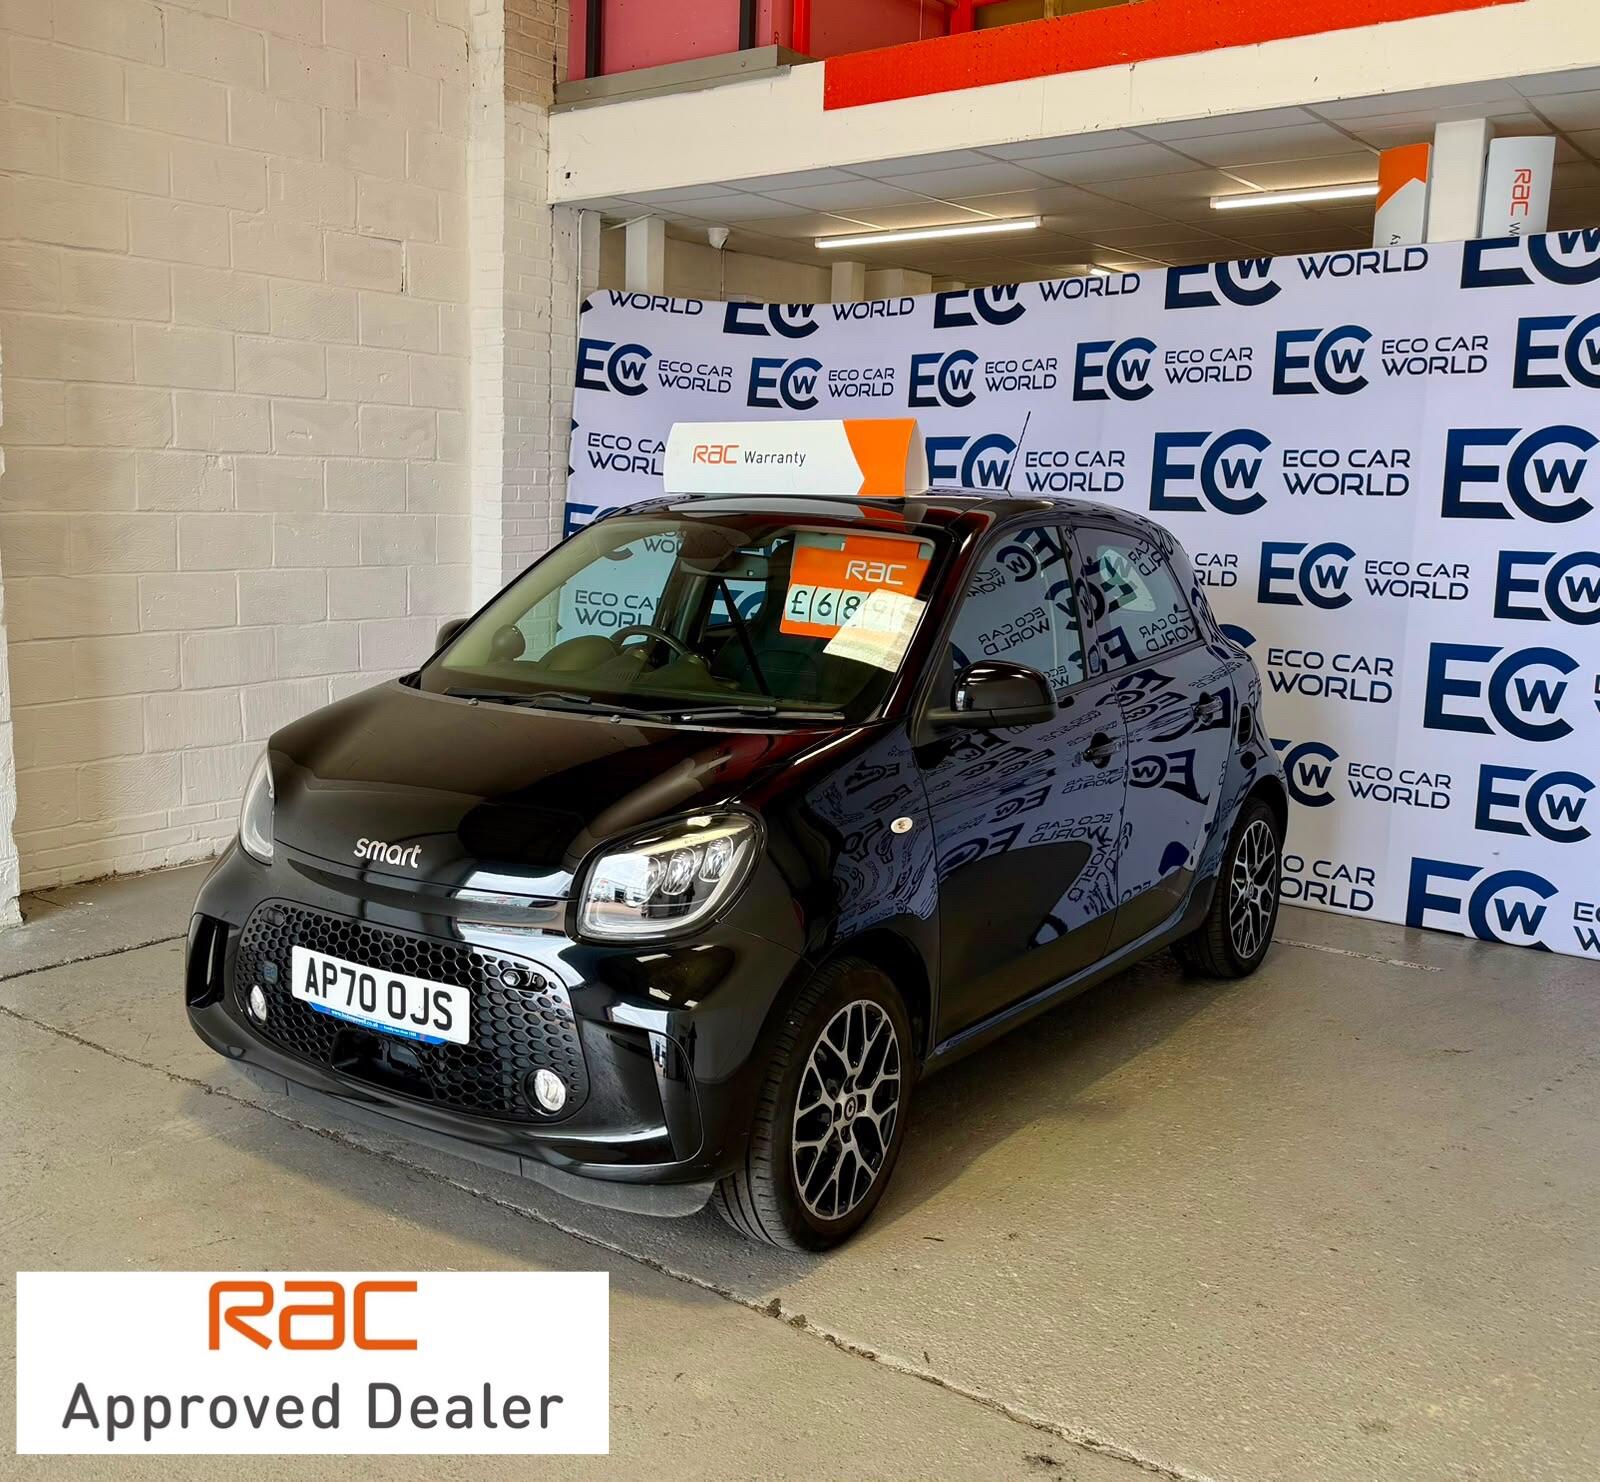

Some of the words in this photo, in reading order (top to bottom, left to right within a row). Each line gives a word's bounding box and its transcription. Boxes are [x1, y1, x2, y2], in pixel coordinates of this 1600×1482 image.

[1297, 247, 1429, 281] WORLD
[1039, 272, 1141, 302] WORLD
[608, 290, 703, 316] WORLD
[832, 298, 915, 321] WORLD
[1165, 349, 1204, 364] ECO
[1209, 347, 1253, 362] CAR
[1381, 338, 1429, 354] ECO
[1435, 335, 1489, 351] CAR
[658, 359, 692, 373] ECO
[697, 364, 733, 377] CAR
[828, 369, 860, 381] ECO
[862, 367, 895, 380] CAR
[985, 360, 1018, 374] ECO
[1022, 358, 1058, 371] CAR
[1164, 364, 1253, 384] WORLD
[1381, 354, 1488, 376] WORLD
[658, 373, 732, 393] WORLD
[828, 382, 895, 398] WORLD
[985, 373, 1057, 392] WORLD
[587, 432, 632, 450] ECO
[638, 439, 667, 454] CA
[587, 450, 663, 476] WORL
[744, 450, 806, 467] Warranty
[1025, 451, 1069, 467] ECO
[1075, 450, 1125, 467] CAR
[1283, 450, 1340, 468] ECO
[1349, 449, 1411, 468] CAR
[1025, 472, 1124, 492] WORLD
[1283, 473, 1410, 496] WORLD
[1195, 553, 1239, 568] CAR
[1365, 560, 1409, 576] ECO
[1416, 562, 1470, 579] CAR
[1194, 570, 1238, 587] RLD
[1364, 578, 1470, 600] WORLD
[575, 589, 618, 606] ECO
[624, 595, 659, 611] CA
[575, 607, 654, 628] WORL
[1267, 648, 1324, 670] ECO
[1332, 653, 1394, 677] CAR
[1267, 670, 1393, 704] WORLD
[1347, 762, 1392, 781] ECO
[1400, 770, 1452, 789] CAR
[1347, 779, 1451, 810] WORLD
[353, 837, 423, 869] smart
[1313, 860, 1375, 887] CAR
[1280, 876, 1374, 912] ORLD
[304, 957, 377, 1013] AP70
[387, 980, 453, 1032] OJS
